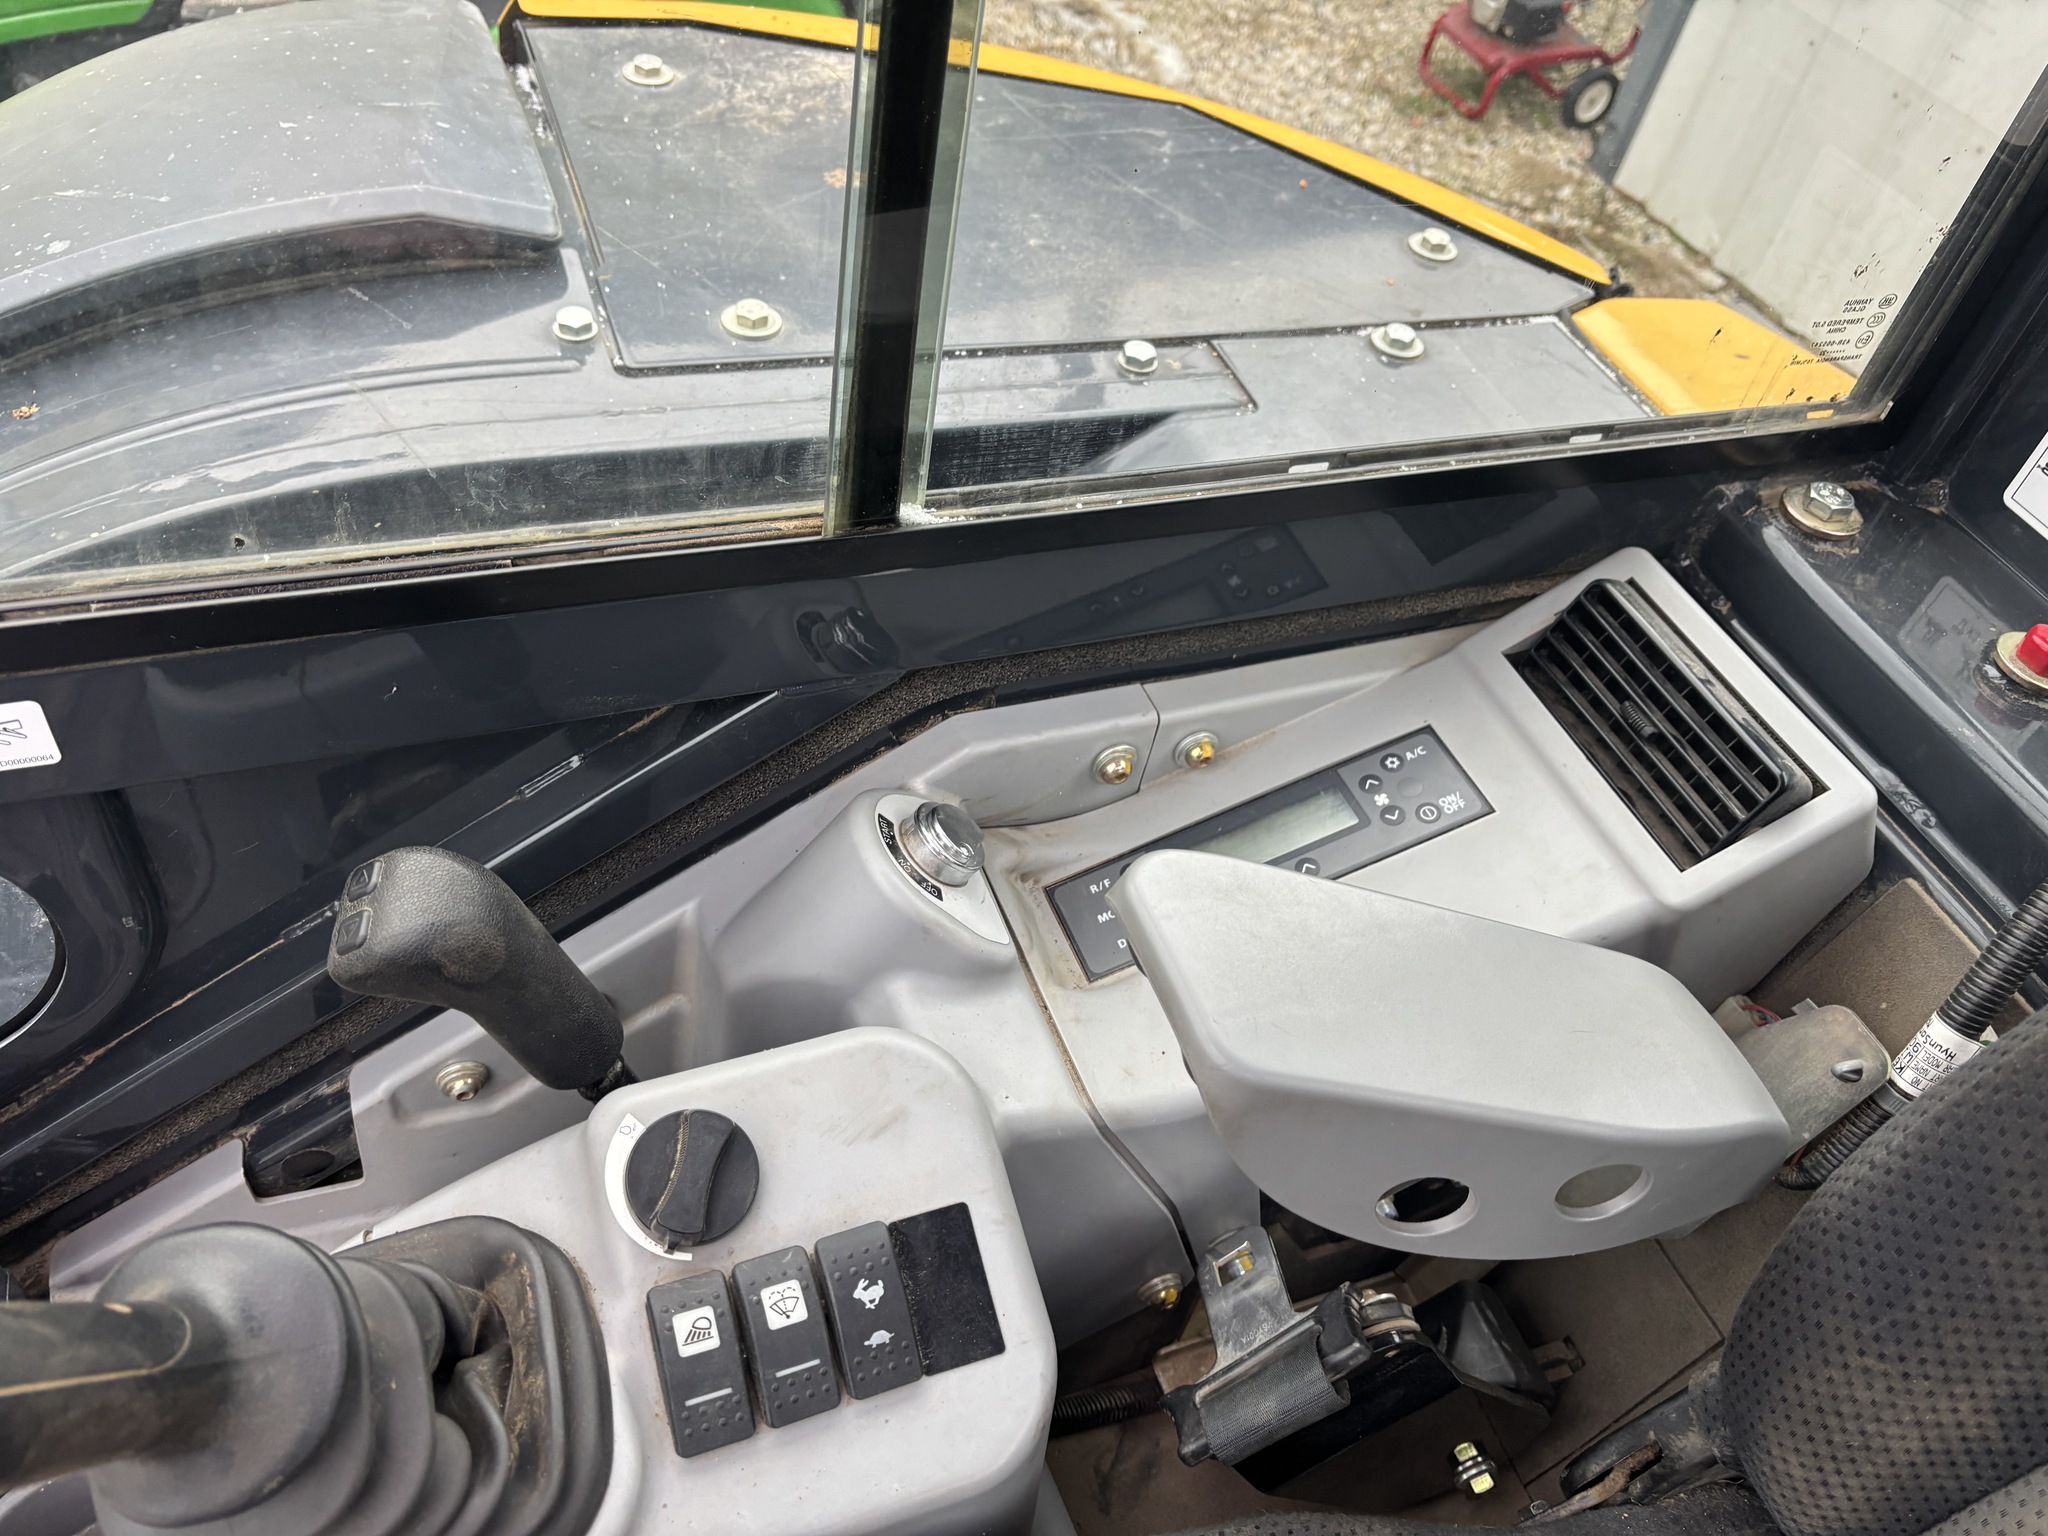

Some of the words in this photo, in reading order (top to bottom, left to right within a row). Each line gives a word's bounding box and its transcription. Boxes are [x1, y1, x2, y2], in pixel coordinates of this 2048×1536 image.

[1405, 745, 1427, 761] A/C
[1438, 791, 1461, 808] ON/
[1443, 798, 1467, 815] OFF
[879, 817, 892, 845] START
[898, 858, 912, 873] ON
[920, 882, 938, 896] OFF
[1089, 878, 1111, 894] R/F
[1921, 1049, 1944, 1070] MODEL
[1911, 1060, 1931, 1077] NAME
